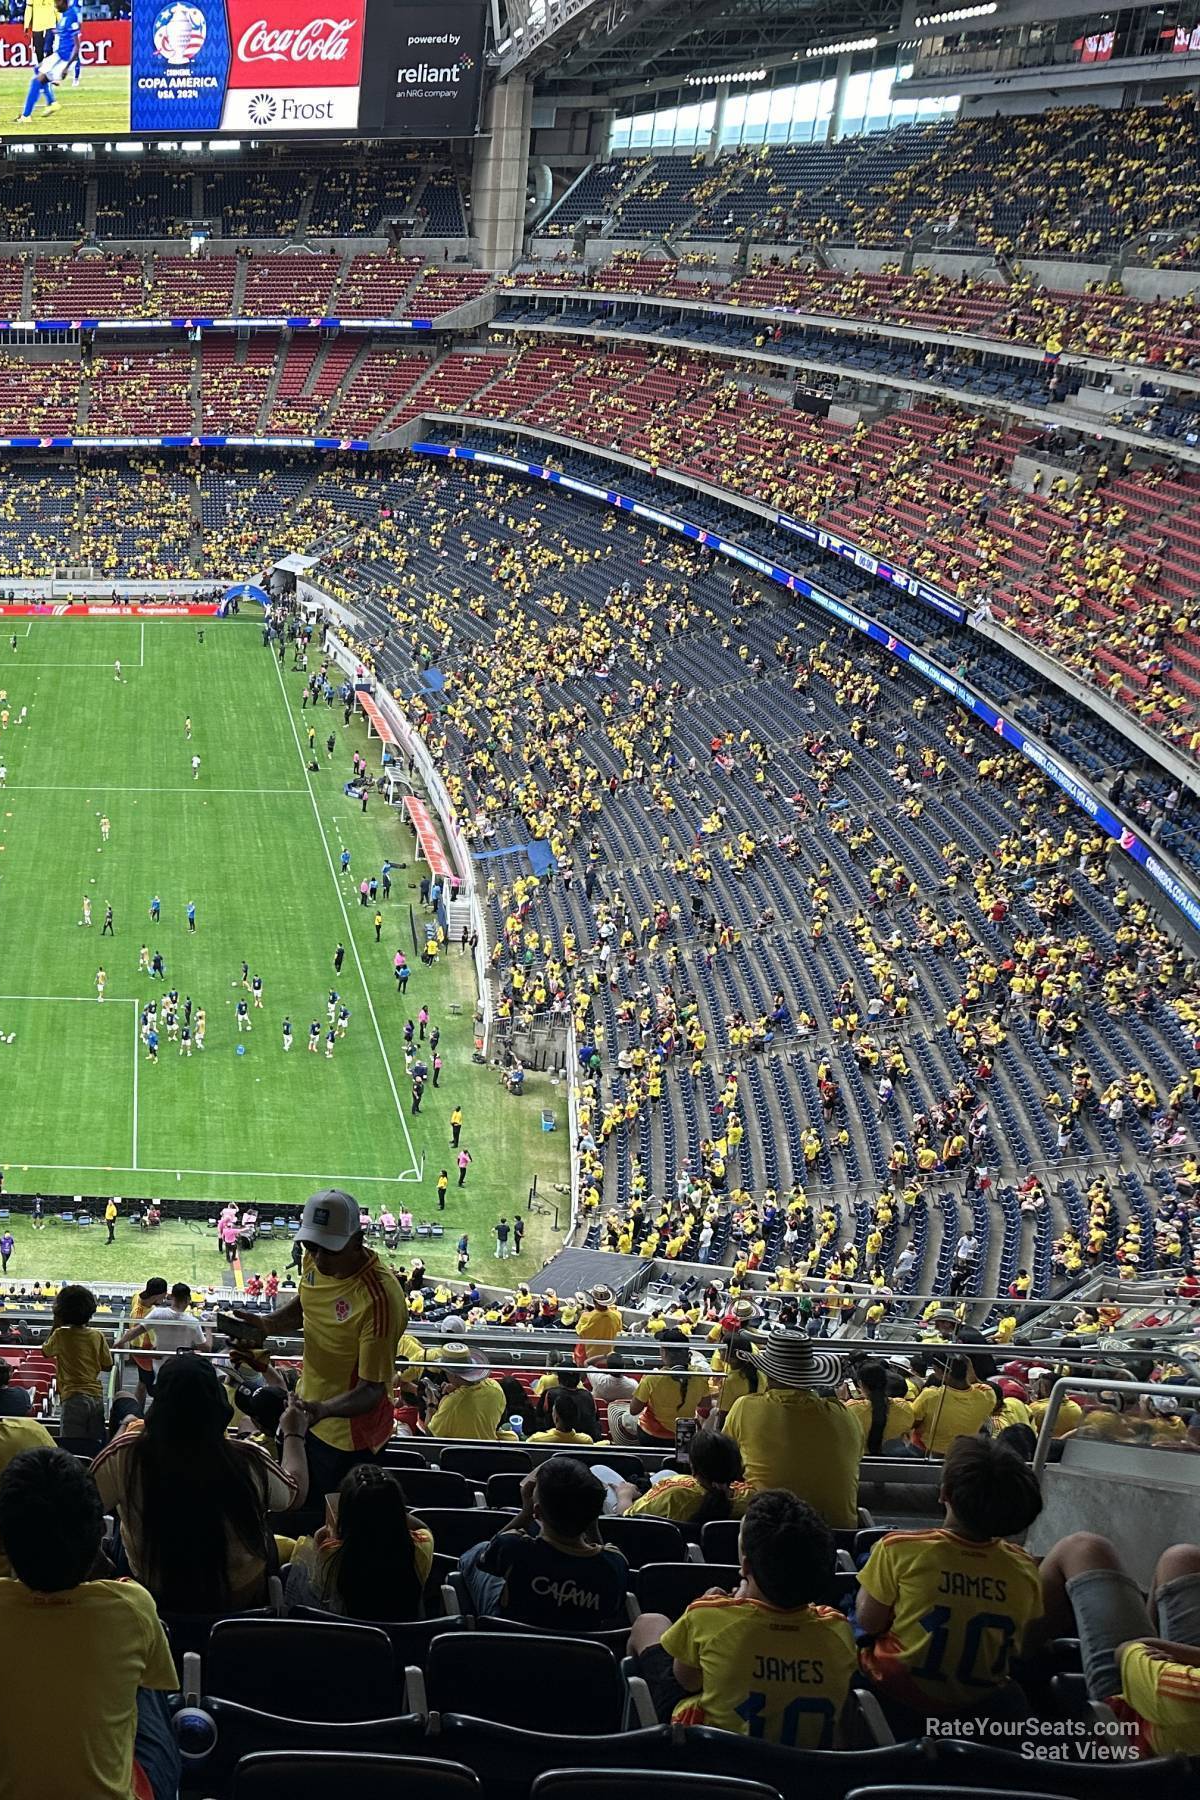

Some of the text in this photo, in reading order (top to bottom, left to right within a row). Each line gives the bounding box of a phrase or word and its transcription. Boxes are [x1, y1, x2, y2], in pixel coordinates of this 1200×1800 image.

[237, 18, 358, 62] Coca-Cola
[407, 34, 460, 46] powered by
[138, 76, 218, 88] COPA AMERICA
[397, 63, 460, 83] reliant
[157, 89, 199, 99] USA 2024
[405, 89, 424, 97] NRG
[424, 90, 458, 98] company
[281, 98, 334, 119] Frost
[938, 1571, 1007, 1602] JAMES
[910, 1604, 1016, 1689] 10
[752, 1655, 825, 1685] JAMES
[734, 1691, 836, 1750] 10
